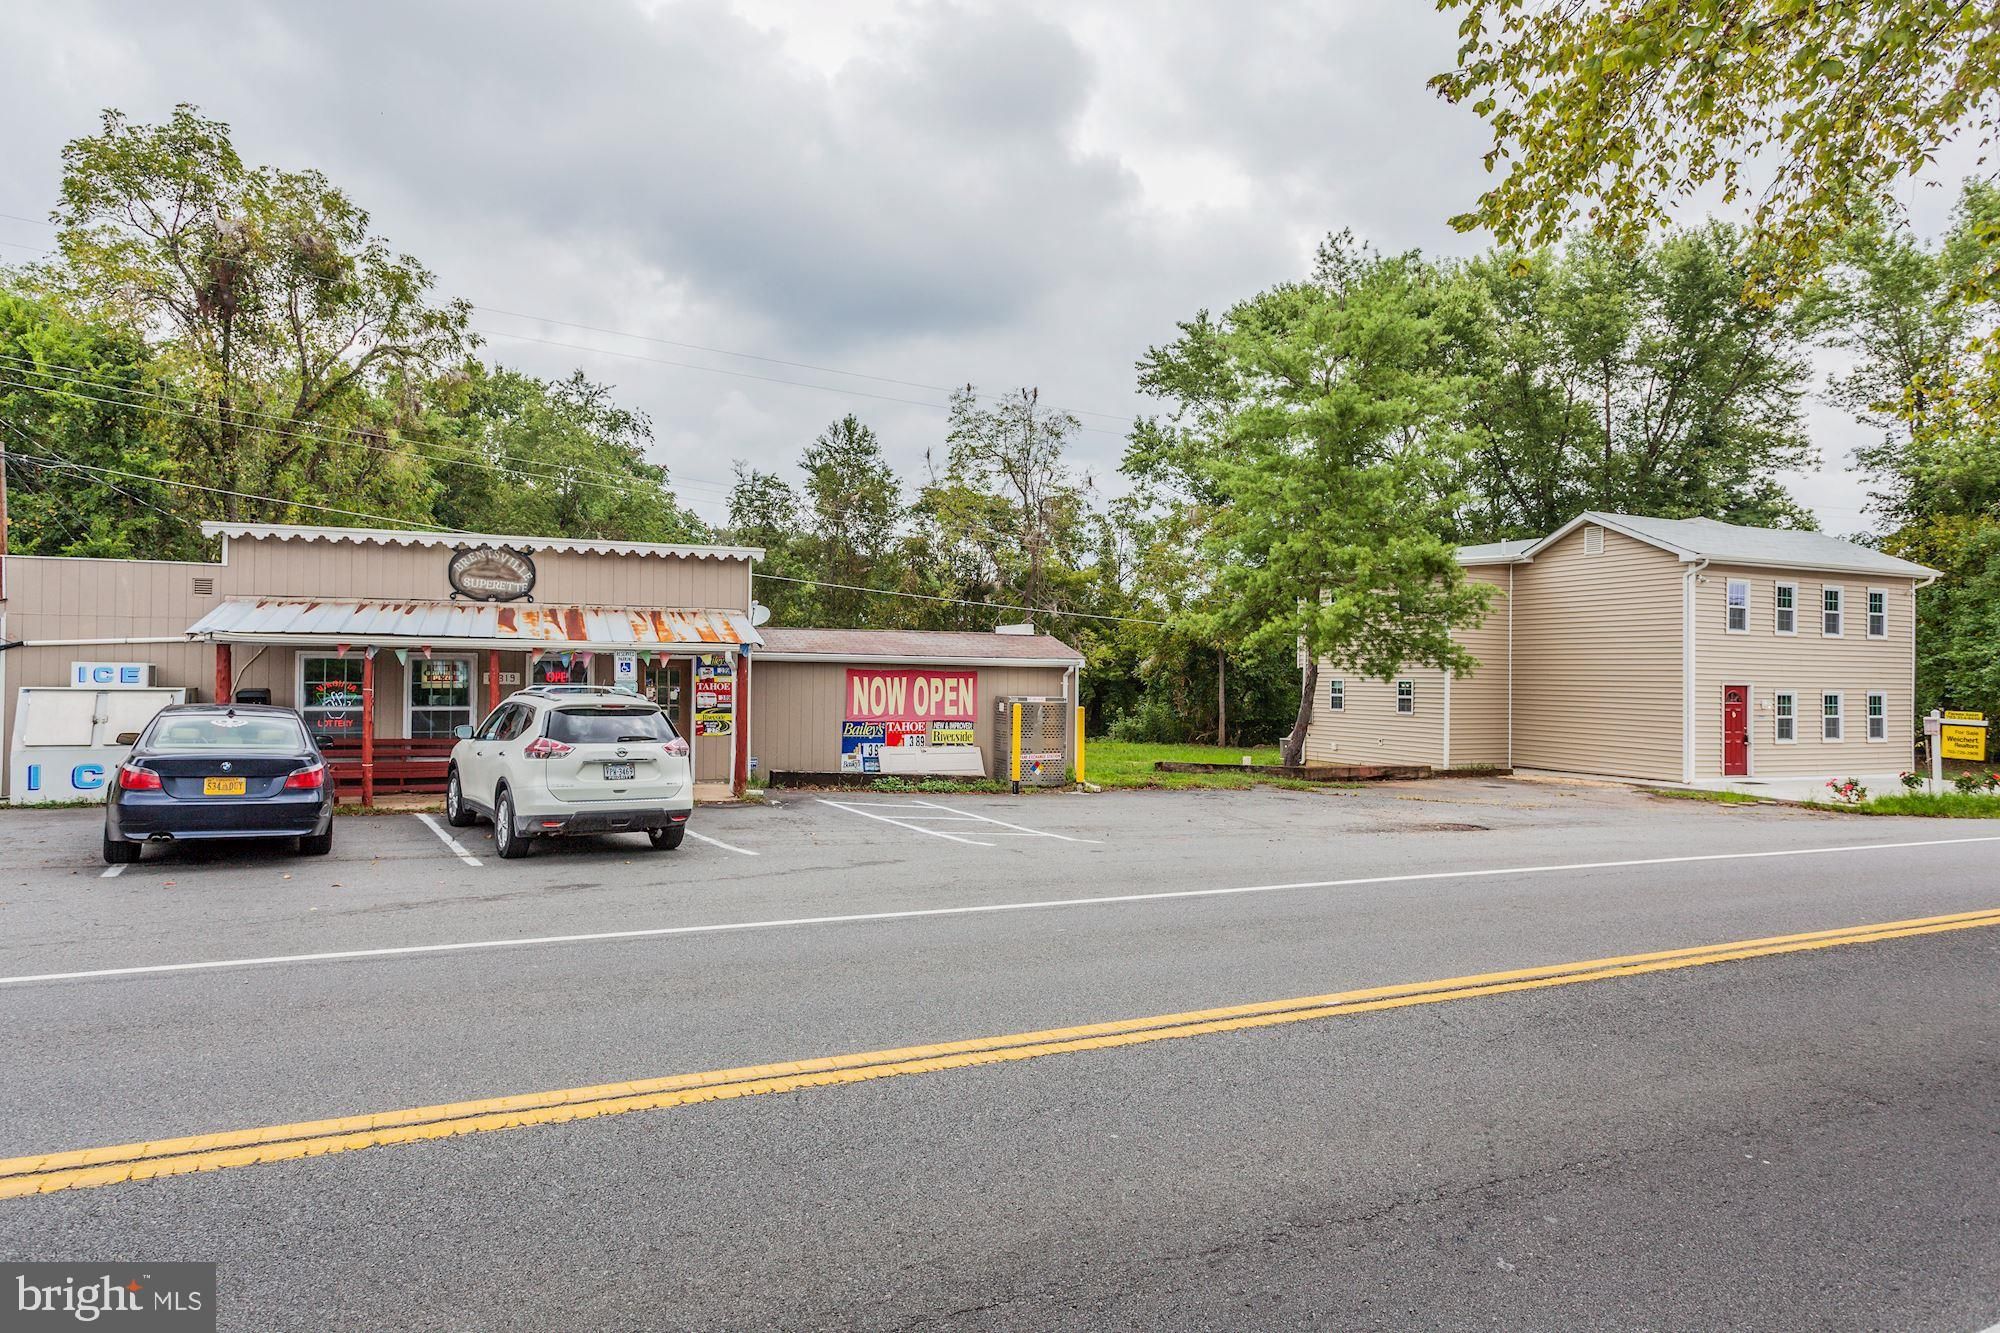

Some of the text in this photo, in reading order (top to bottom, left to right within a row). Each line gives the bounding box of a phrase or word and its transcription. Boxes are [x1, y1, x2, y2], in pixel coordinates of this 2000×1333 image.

[453, 549, 533, 581] BRENTSVILLE
[463, 577, 528, 592] SUPERETTE
[78, 666, 141, 684] ICE
[545, 671, 568, 683] OPE
[315, 679, 358, 692] VRGINA
[696, 682, 731, 691] TAHOE
[853, 676, 974, 716] NOW OPEN
[317, 719, 354, 728] LOTTERY
[886, 721, 926, 732] TAHOE
[843, 722, 885, 739] Bailey's
[933, 731, 973, 742] Riverside
[1946, 736, 1979, 744] Weichert
[27, 763, 105, 791] IC
